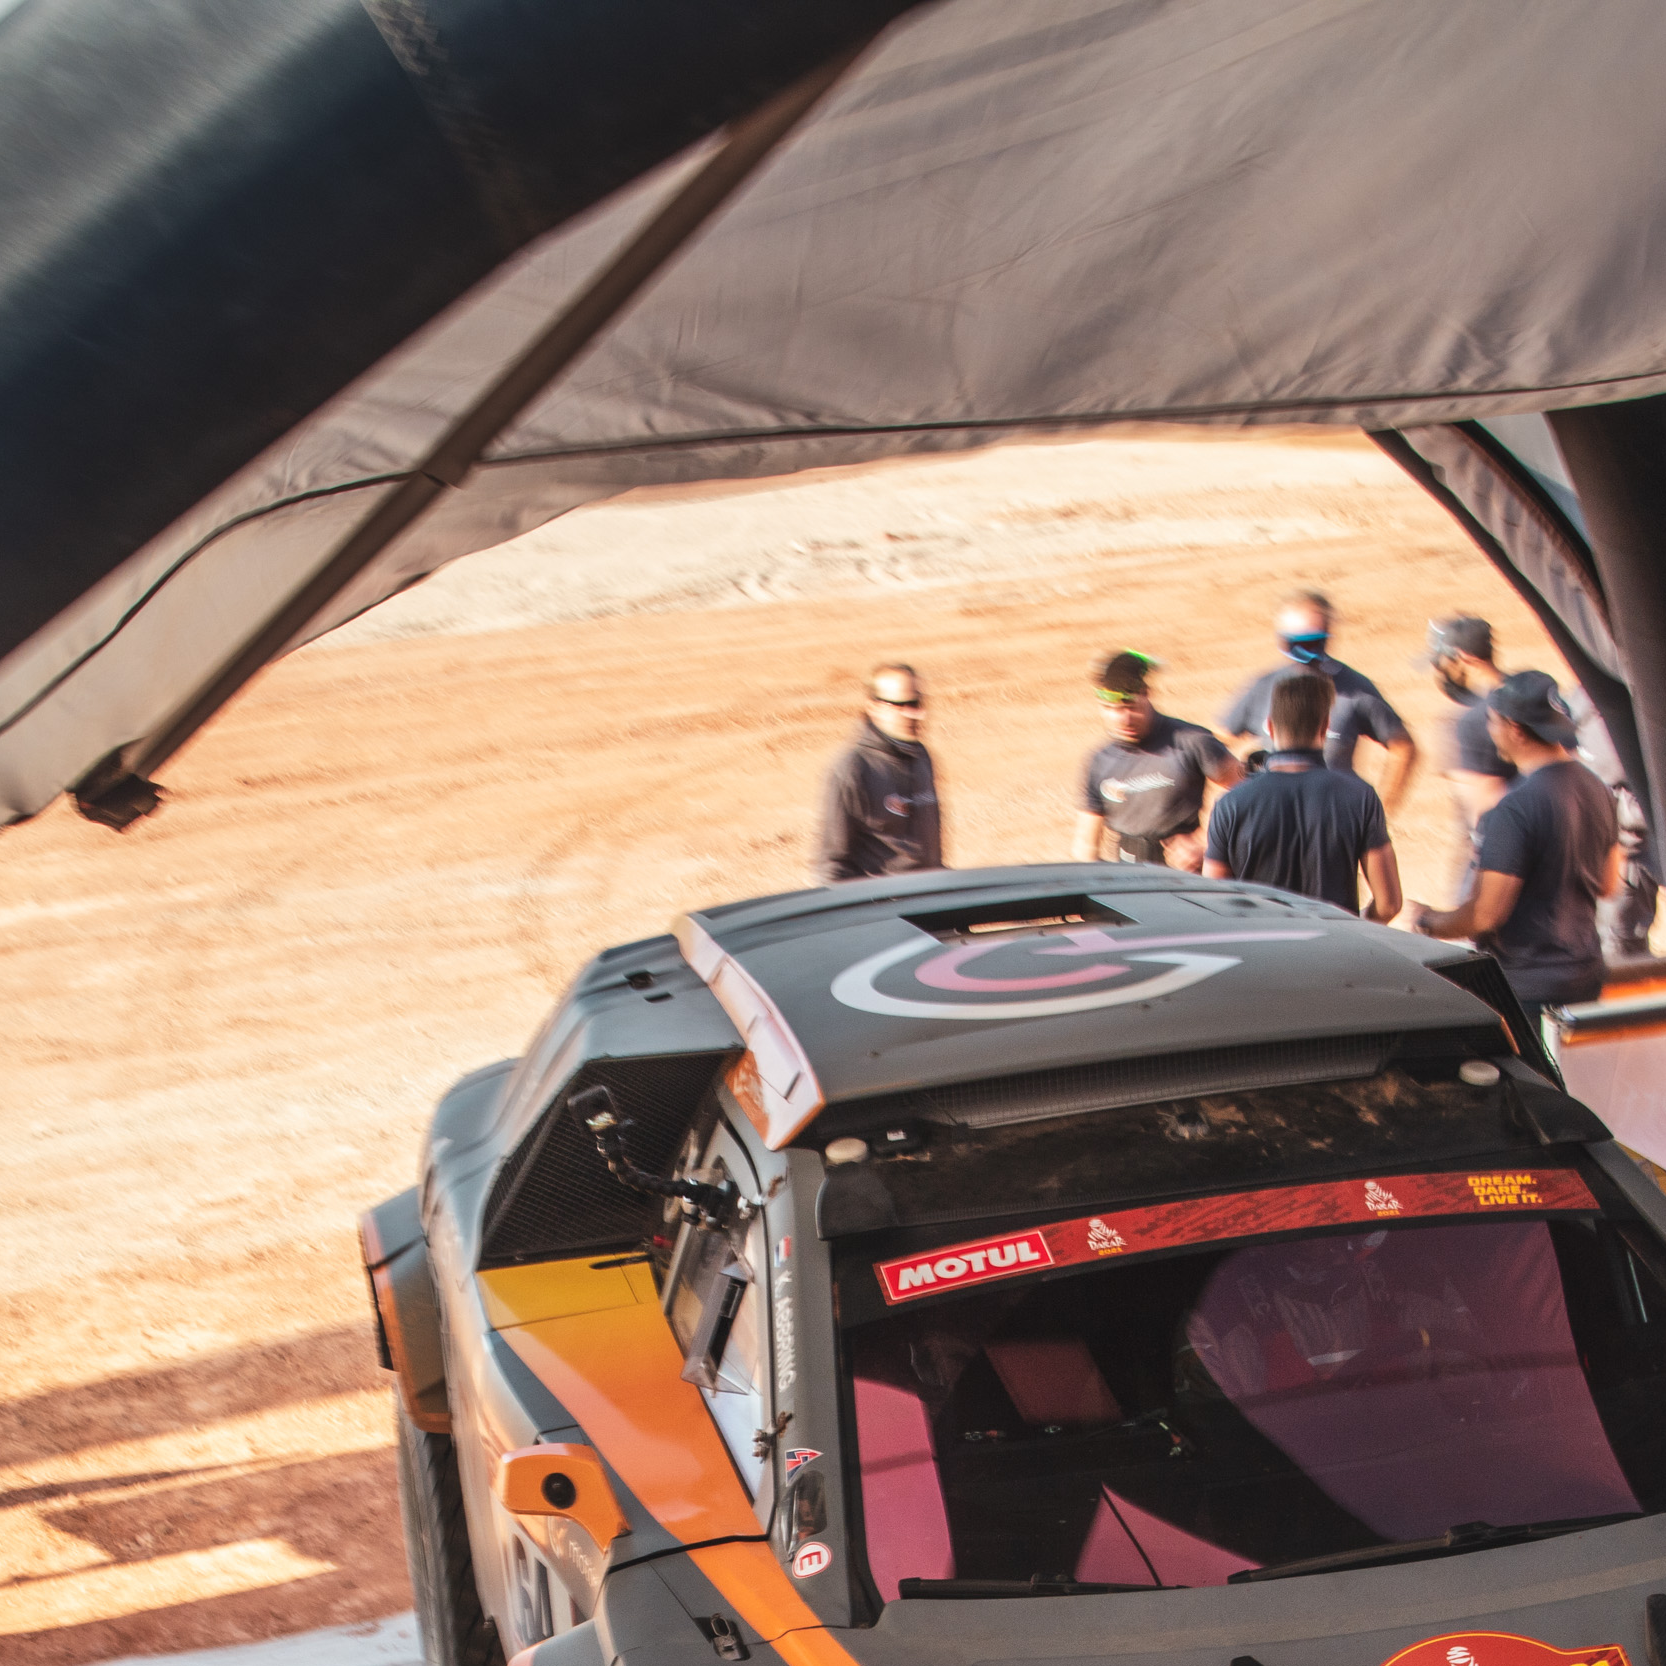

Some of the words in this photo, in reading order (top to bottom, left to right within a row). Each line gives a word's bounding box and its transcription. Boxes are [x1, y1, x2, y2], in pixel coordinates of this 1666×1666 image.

[1467, 1173, 1537, 1187] DREAM.
[1473, 1184, 1527, 1196] DARE.
[1364, 1198, 1404, 1211] DAKAR
[1479, 1194, 1519, 1206] LIVE
[1521, 1192, 1543, 1204] IT.
[1087, 1236, 1128, 1250] DAKAR
[897, 1241, 1041, 1291] MOTUL
